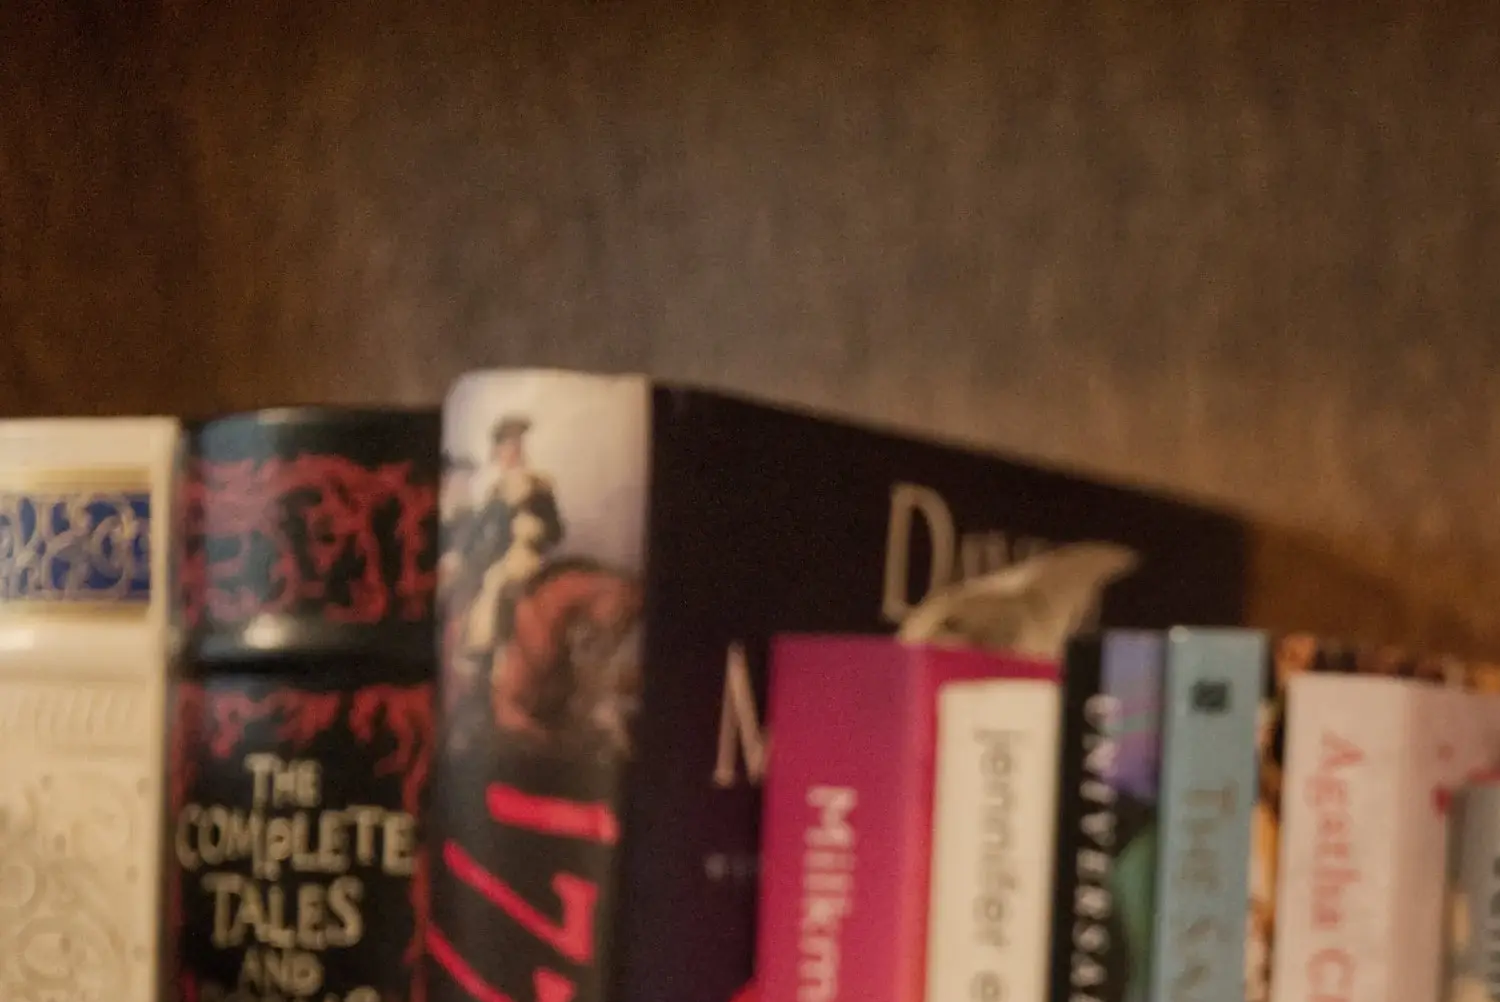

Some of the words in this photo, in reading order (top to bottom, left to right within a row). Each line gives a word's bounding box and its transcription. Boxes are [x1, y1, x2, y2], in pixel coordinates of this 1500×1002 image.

[243, 751, 322, 808] THE
[176, 803, 417, 879] COMPLETE
[203, 875, 363, 948] TALES
[239, 950, 324, 997] AND
